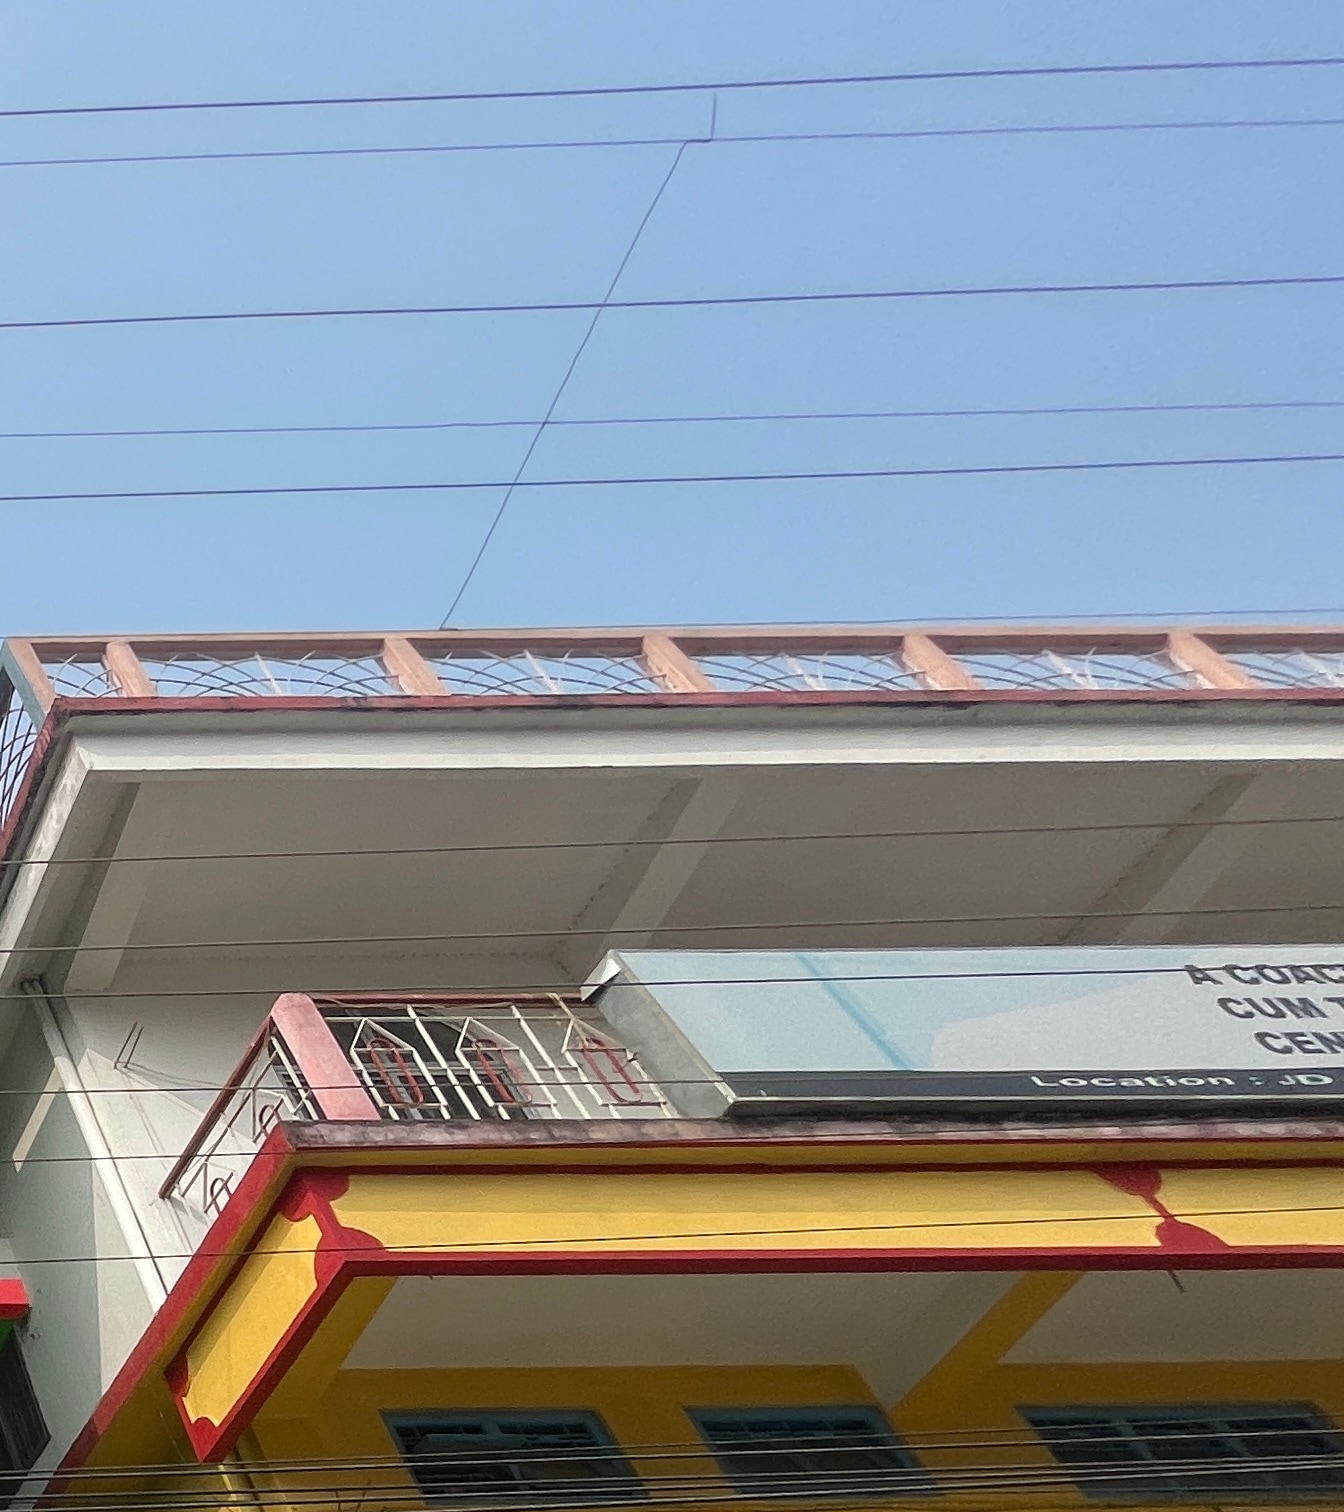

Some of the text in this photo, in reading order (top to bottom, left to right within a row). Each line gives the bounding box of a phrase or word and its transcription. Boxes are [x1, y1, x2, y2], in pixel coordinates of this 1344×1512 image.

[1184, 964, 1224, 985] A
[1217, 997, 1329, 1019] CUM
[1030, 1075, 1235, 1087] Location
[1279, 1073, 1334, 1087] JD
